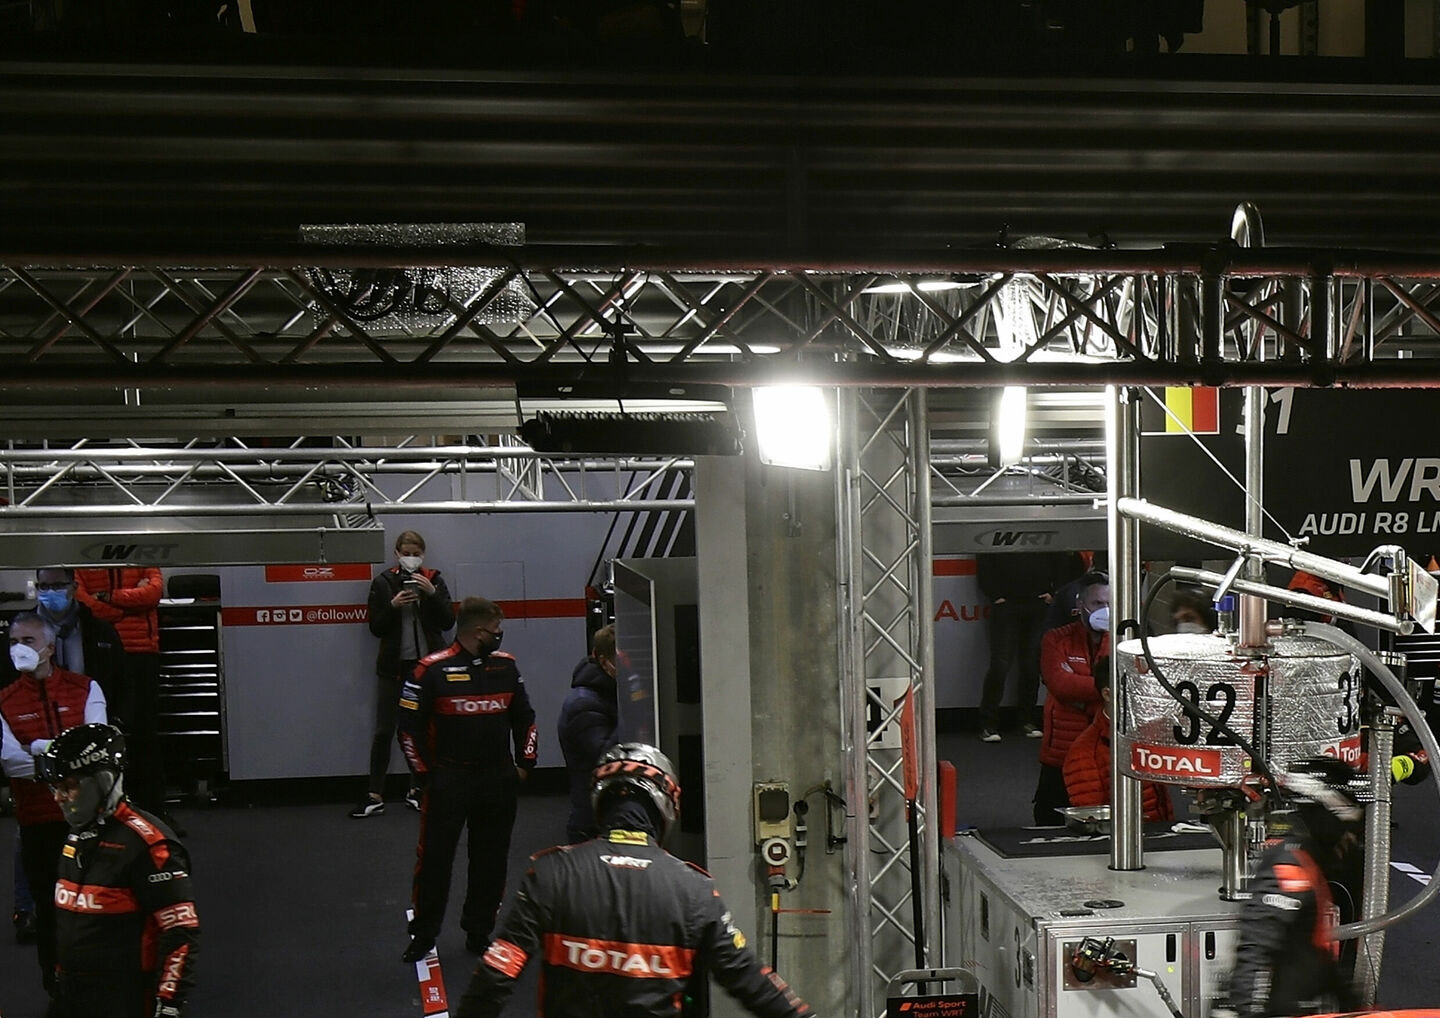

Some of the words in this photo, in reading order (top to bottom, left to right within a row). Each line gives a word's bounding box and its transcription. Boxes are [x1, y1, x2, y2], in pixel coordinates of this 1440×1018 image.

[1299, 512, 1366, 536] AUDI
[1373, 512, 1408, 534] R8
[992, 531, 1059, 546] WRT
[101, 543, 179, 560] WRT
[450, 698, 508, 712] TOTAL
[1173, 680, 1236, 746] 32
[69, 747, 110, 770] uvex
[1136, 748, 1212, 774] TOTAL
[55, 883, 103, 910] TOTAL
[562, 939, 672, 974] TOTAL
[938, 1001, 966, 1009] Sport
[941, 1009, 965, 1017] WRT
